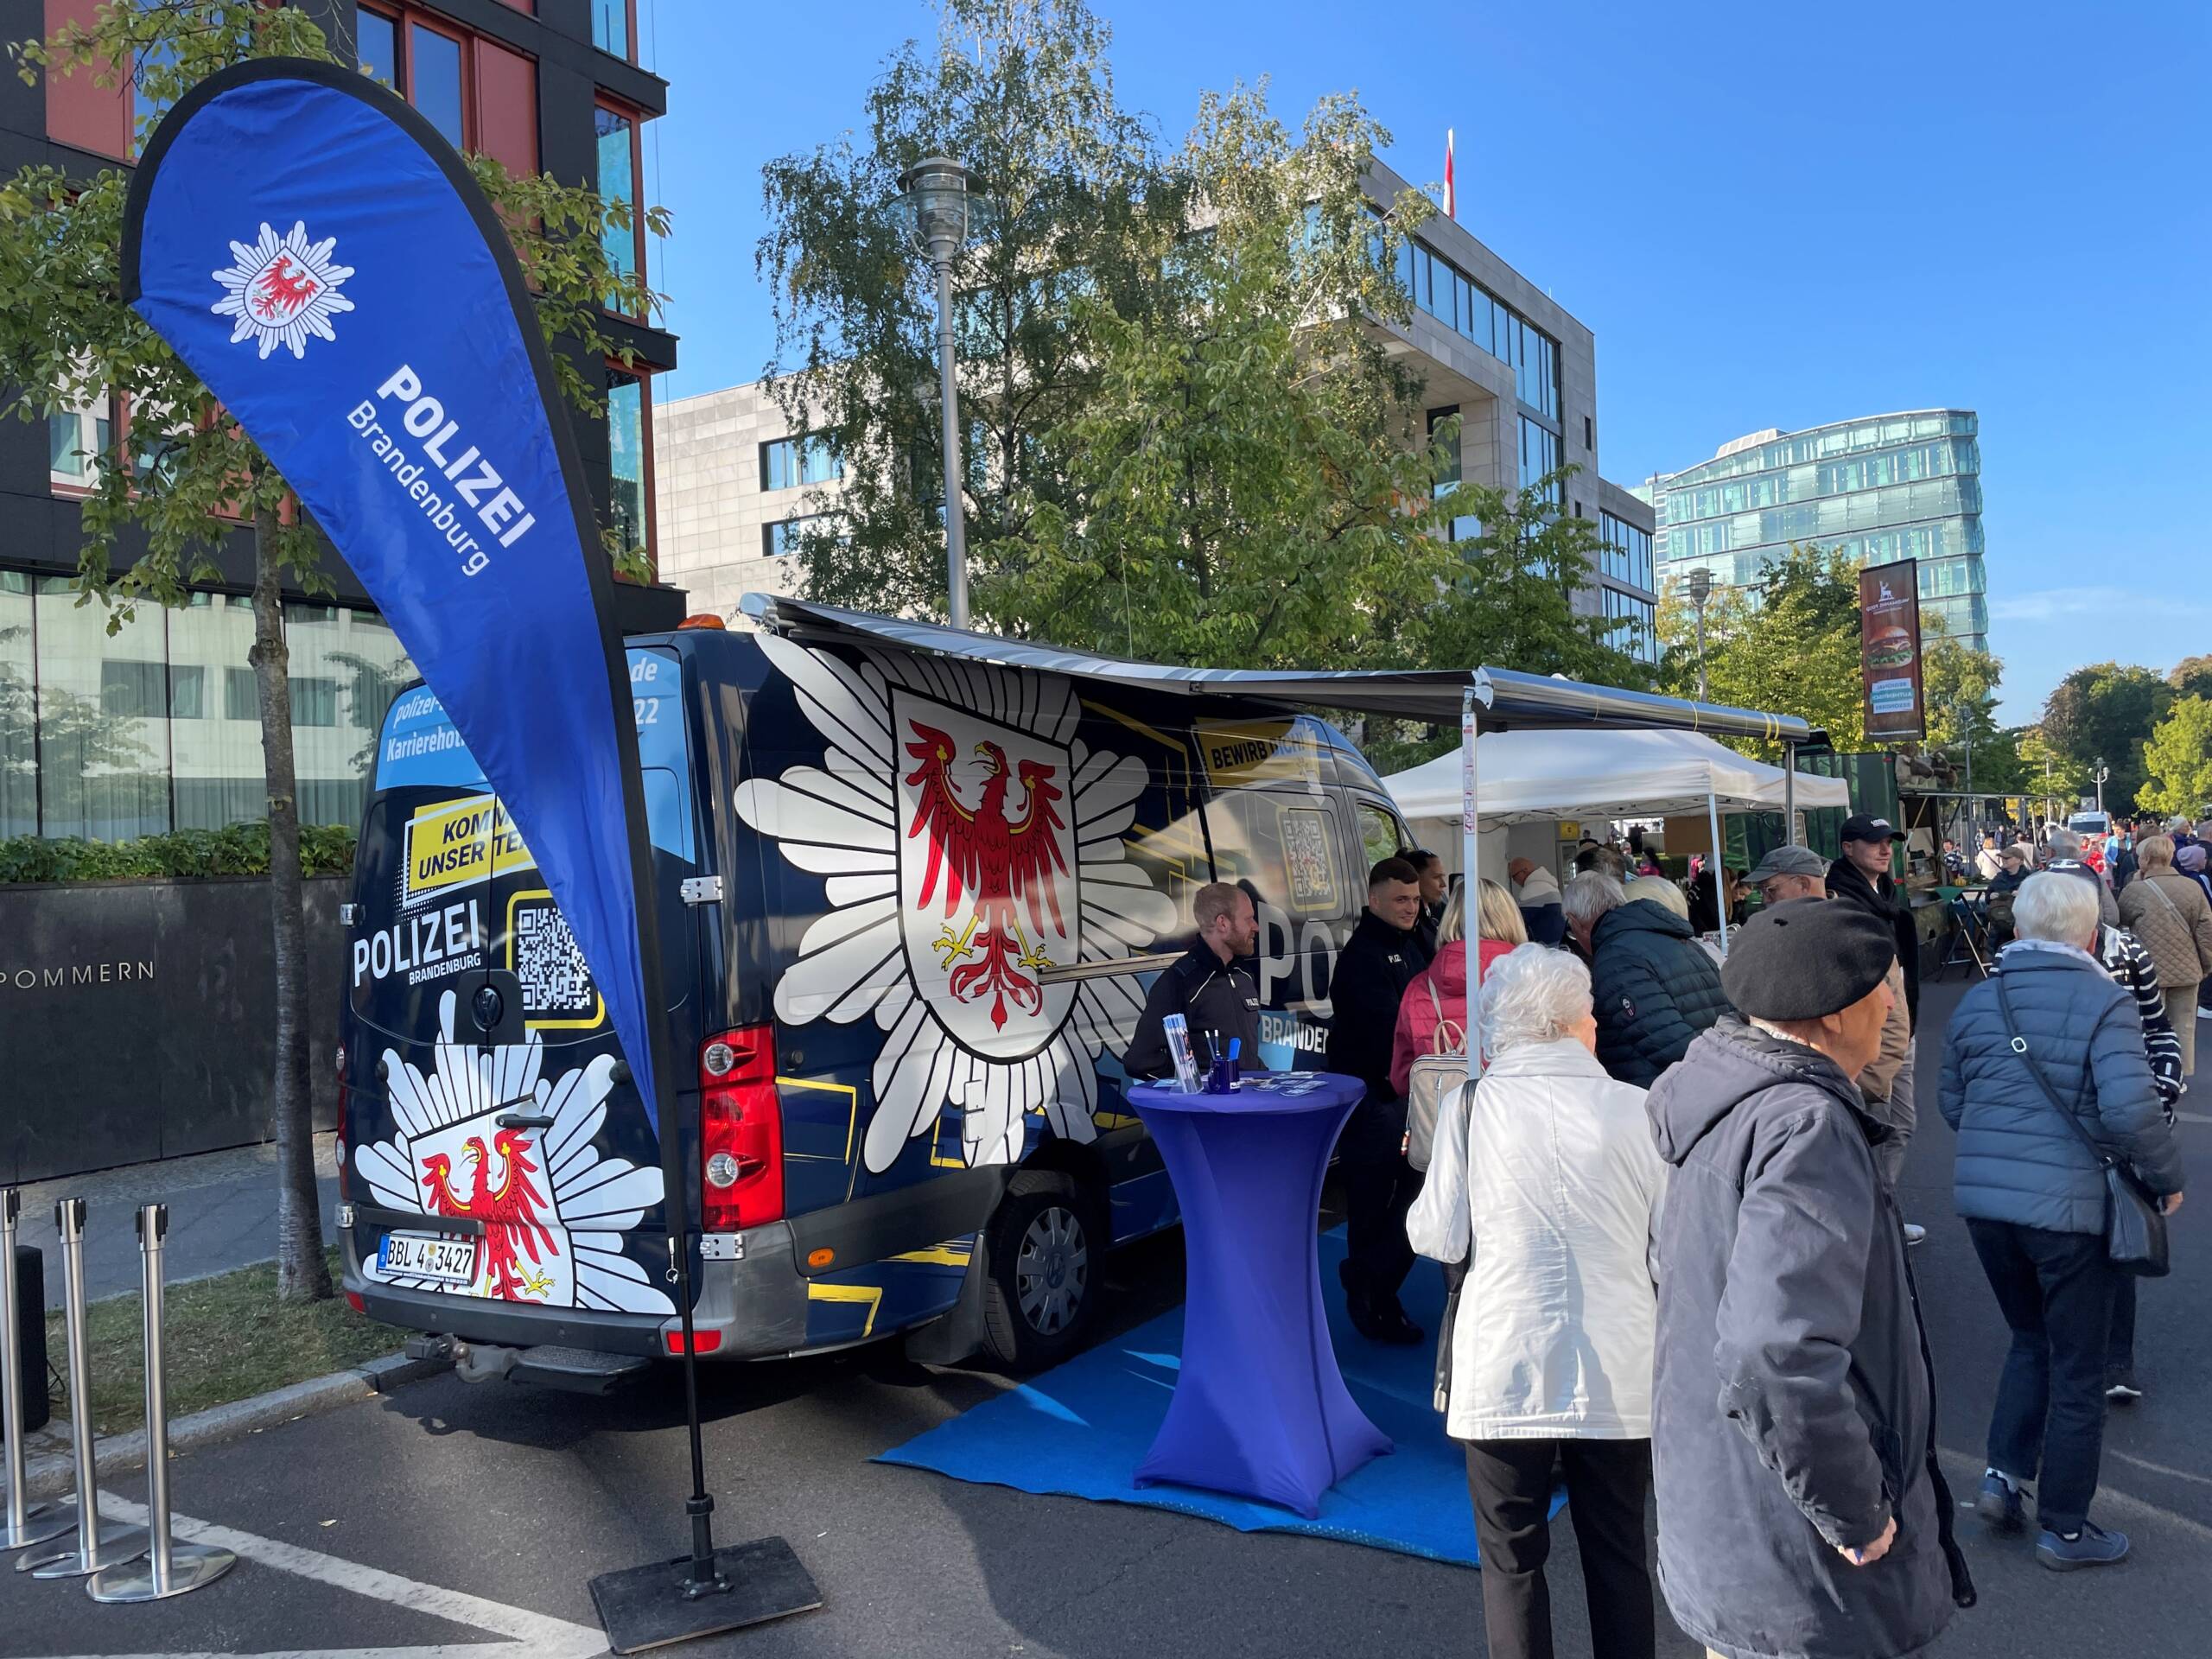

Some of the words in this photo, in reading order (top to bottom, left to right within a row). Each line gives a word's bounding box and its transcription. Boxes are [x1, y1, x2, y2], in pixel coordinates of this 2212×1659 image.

[346, 399, 491, 577] Brandenburg
[376, 364, 536, 549] POLIZEI
[392, 695, 443, 729] polizei-
[630, 657, 658, 683] de
[386, 726, 465, 762] Karrierehot
[634, 697, 659, 725] 22
[1211, 741, 1268, 769] BEWIRB
[418, 840, 486, 880] UNSER
[494, 830, 525, 857] TE
[353, 899, 480, 988] POLIZEI
[409, 952, 481, 986] BRANDENBURG
[387, 1240, 412, 1267] BBL
[416, 1243, 425, 1268] 4
[435, 1245, 473, 1274] 3427
